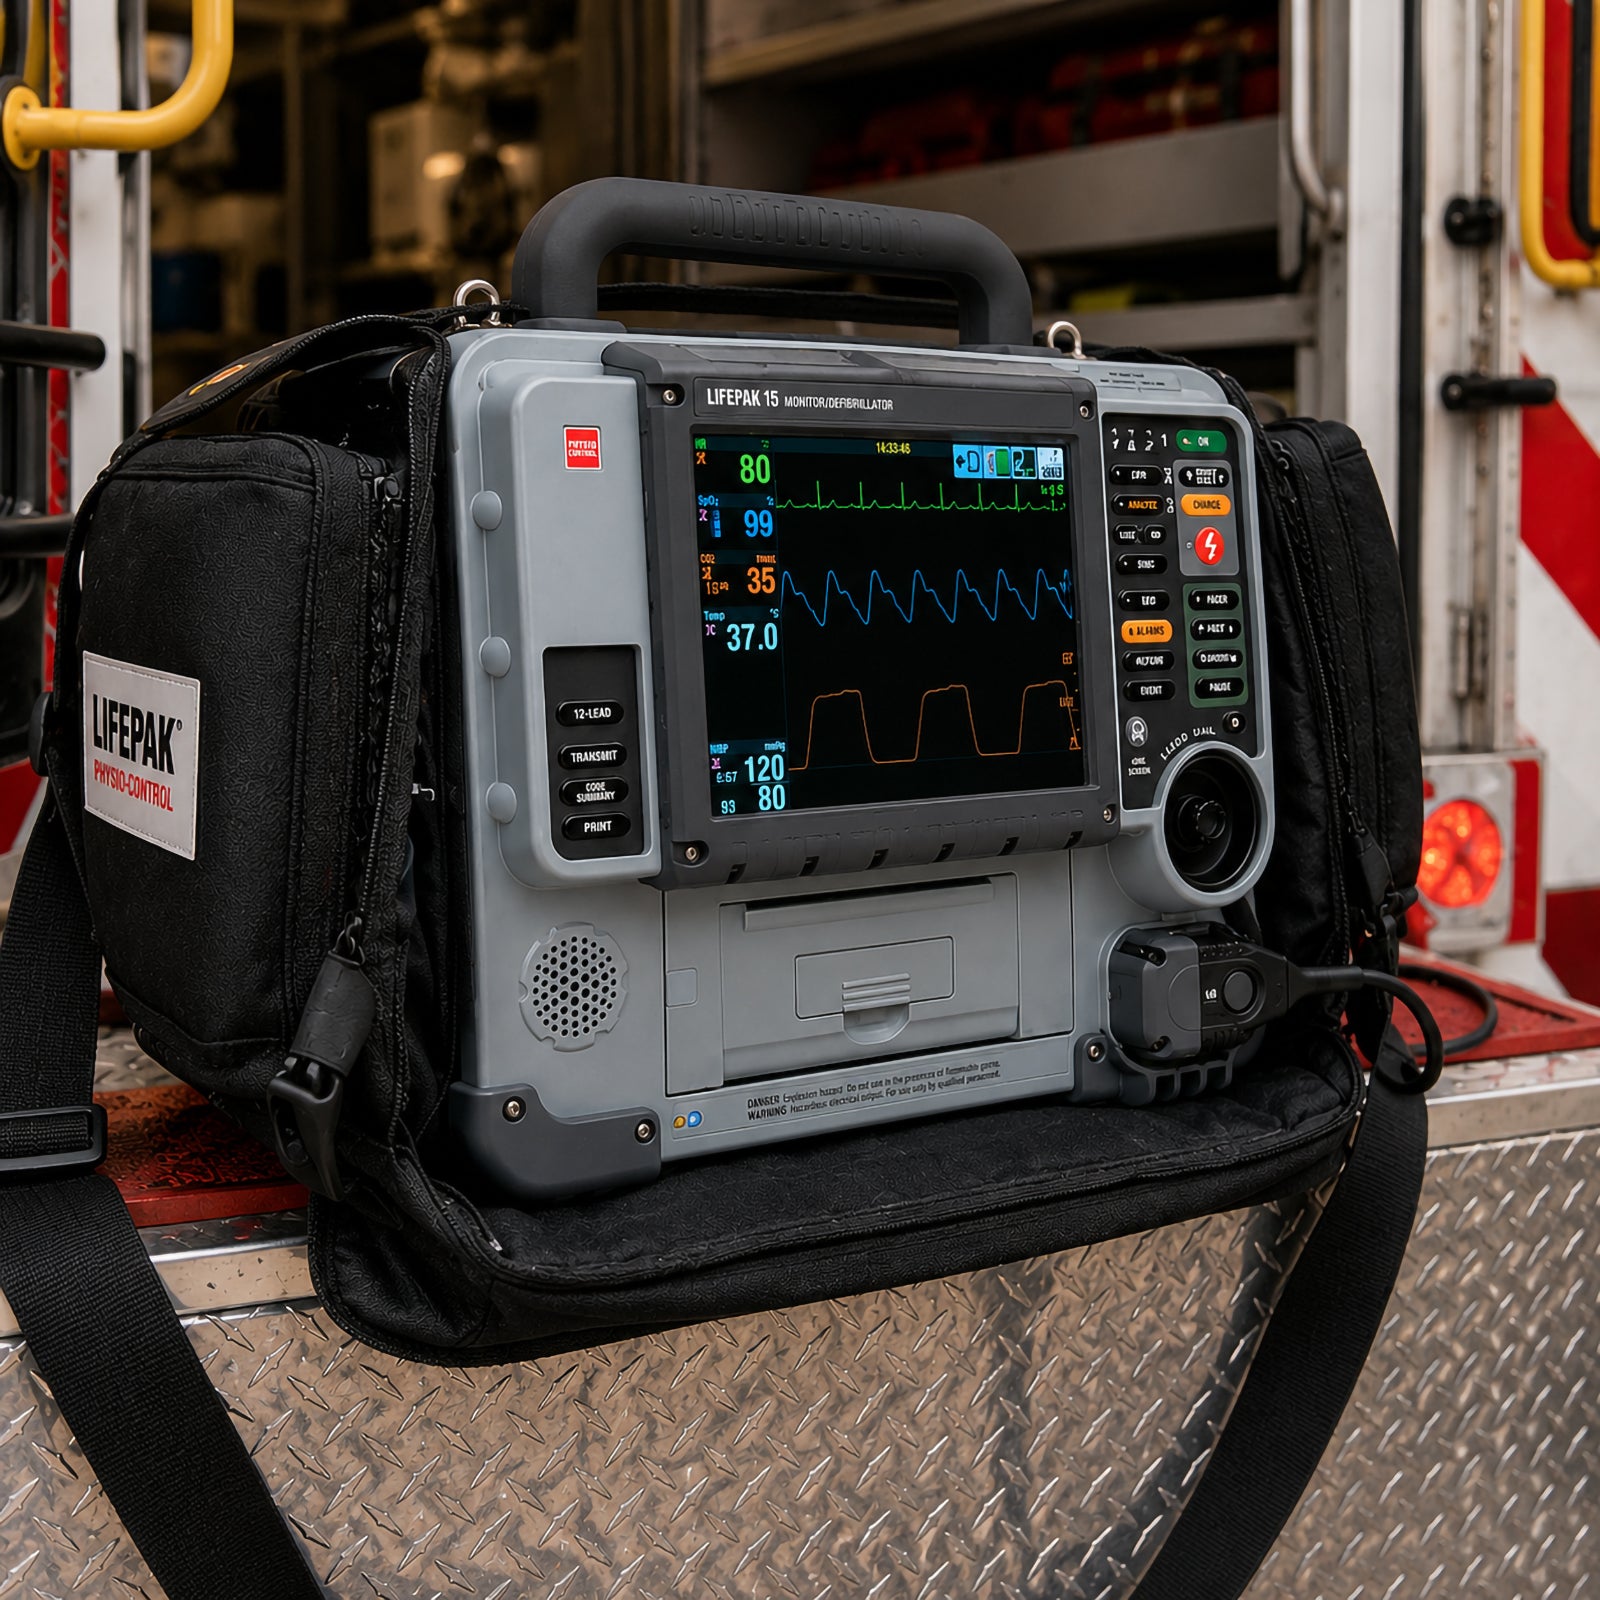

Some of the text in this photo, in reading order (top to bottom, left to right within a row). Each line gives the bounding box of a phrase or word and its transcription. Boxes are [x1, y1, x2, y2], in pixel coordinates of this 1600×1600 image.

[707, 387, 761, 407] LIFEPAK
[763, 389, 779, 407] 15
[740, 453, 771, 484] 80
[743, 509, 774, 538] 99
[747, 566, 776, 594] 35
[726, 622, 779, 652] 37.0
[573, 707, 612, 720] 12-LEAD
[744, 754, 785, 783] 120
[94, 758, 174, 812] PHYSIO-CONTROL
[758, 784, 786, 811] 80
[584, 820, 612, 833] PRINT
